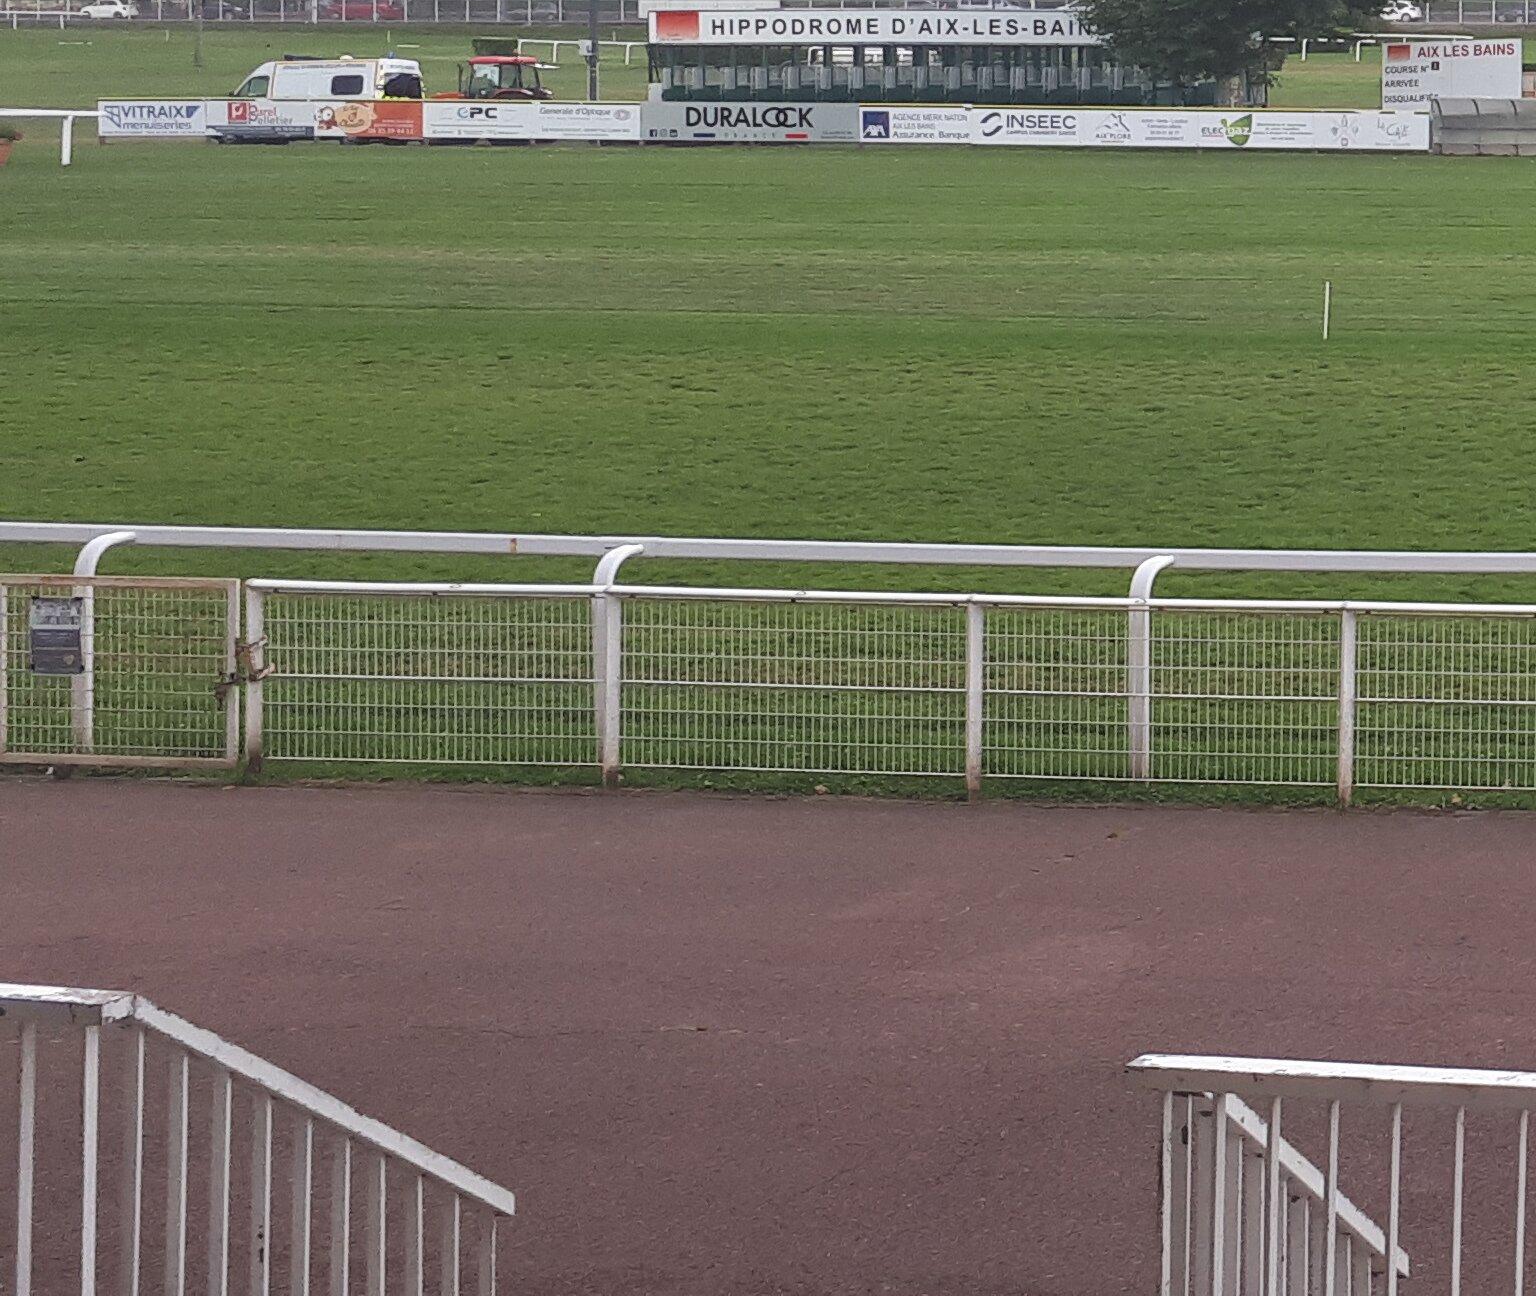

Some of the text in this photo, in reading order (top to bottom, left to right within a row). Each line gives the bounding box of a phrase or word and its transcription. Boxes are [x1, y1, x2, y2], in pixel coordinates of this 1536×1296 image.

[711, 18, 1092, 35] HIPPODROME D'AIX-LES-BAIN
[1417, 43, 1515, 58] AIX LES BAINS
[1385, 65, 1418, 74] COURSE
[120, 105, 185, 119] VITRAIX
[685, 107, 814, 128] DURALOCK
[122, 121, 192, 130] menuiseries
[1006, 114, 1077, 130] INSEEC
[893, 131, 970, 141] Assurance Banque
